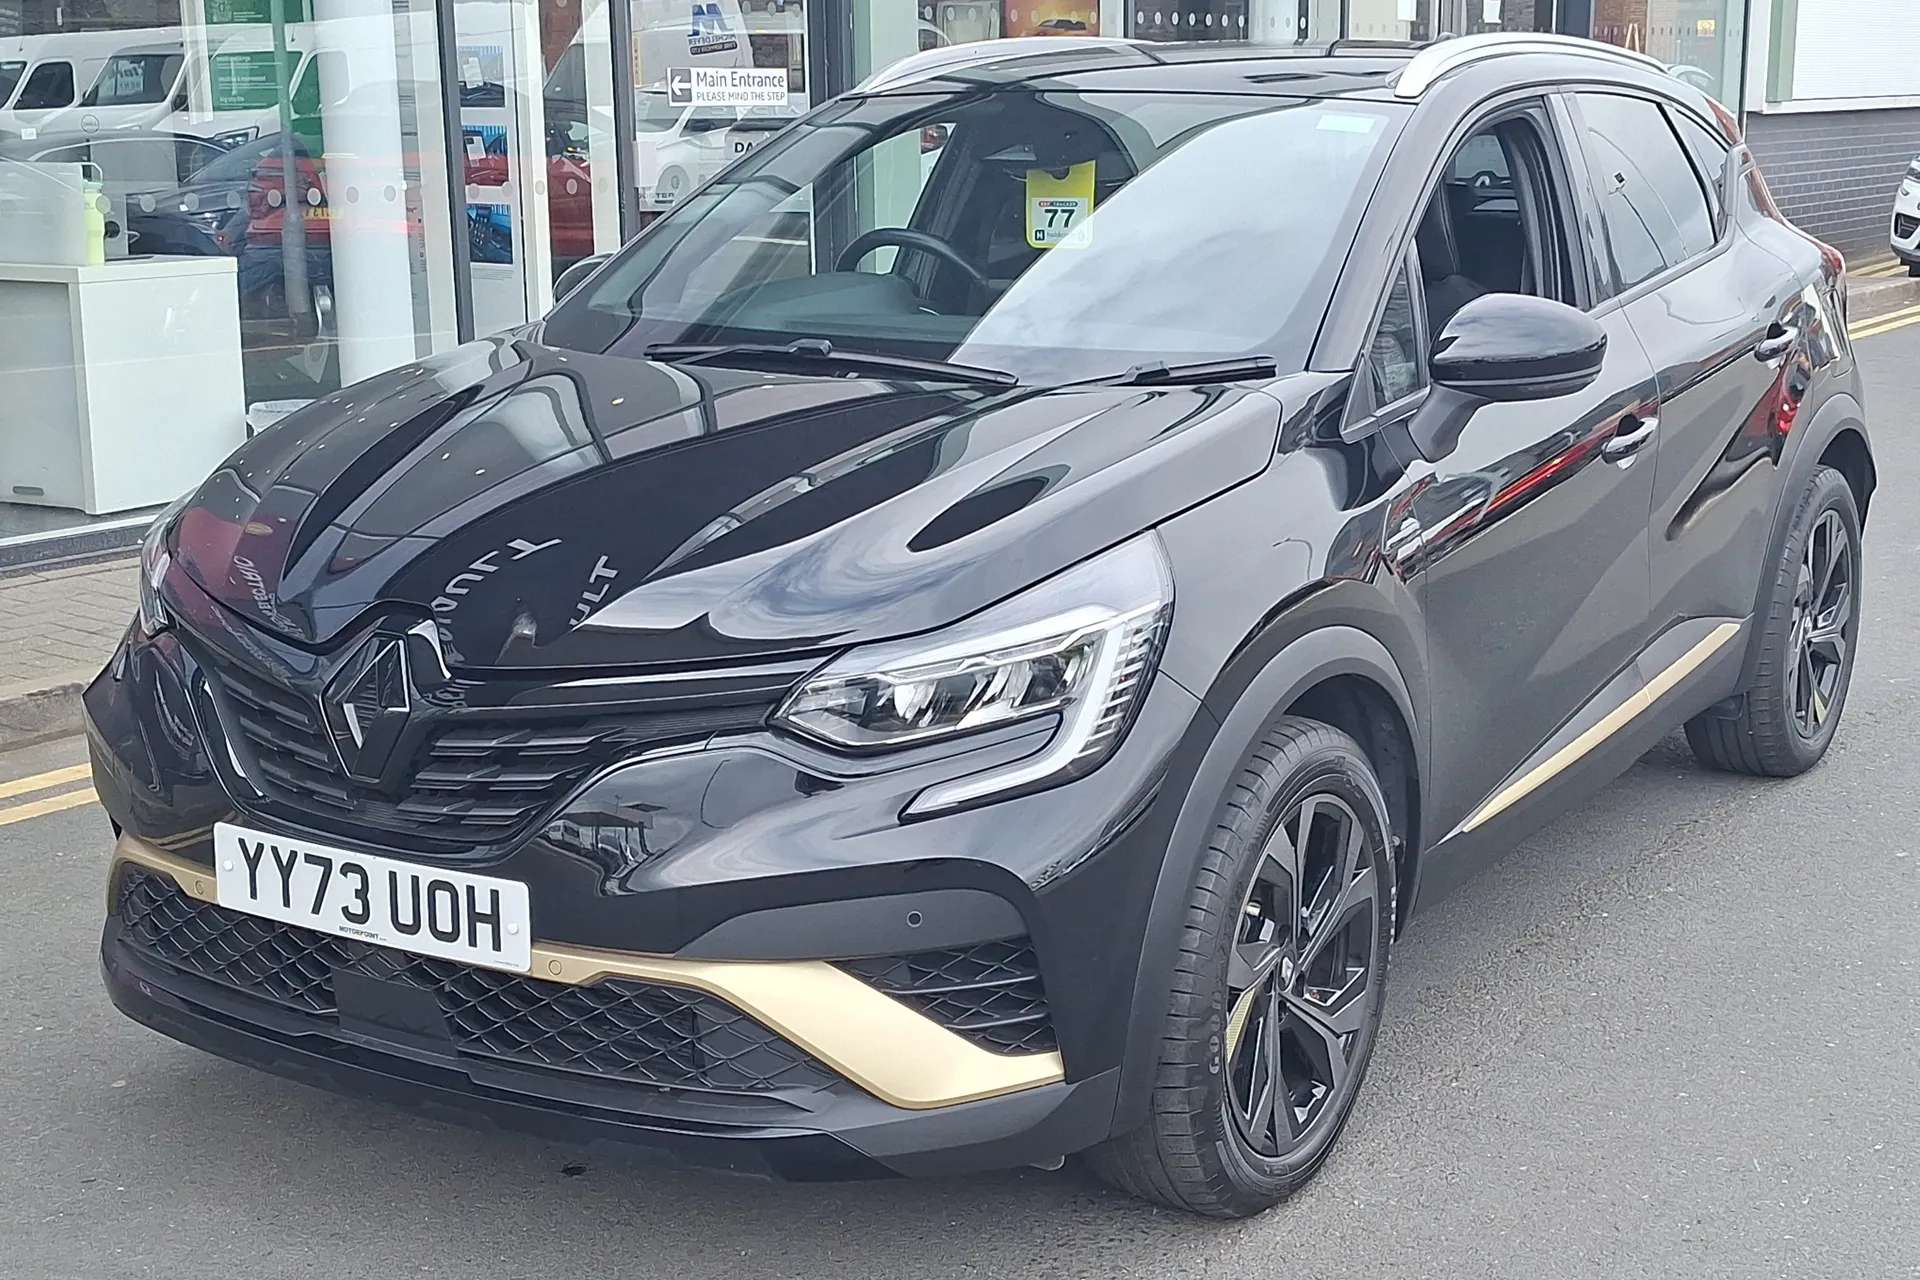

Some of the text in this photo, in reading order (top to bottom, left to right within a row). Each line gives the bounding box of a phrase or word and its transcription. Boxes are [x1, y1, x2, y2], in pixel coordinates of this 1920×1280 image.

[696, 71, 785, 88] Main Entrance
[696, 92, 786, 101] PLEASE MIND THE STEP
[1045, 209, 1075, 228] 77
[238, 837, 502, 952] YY73 UOH
